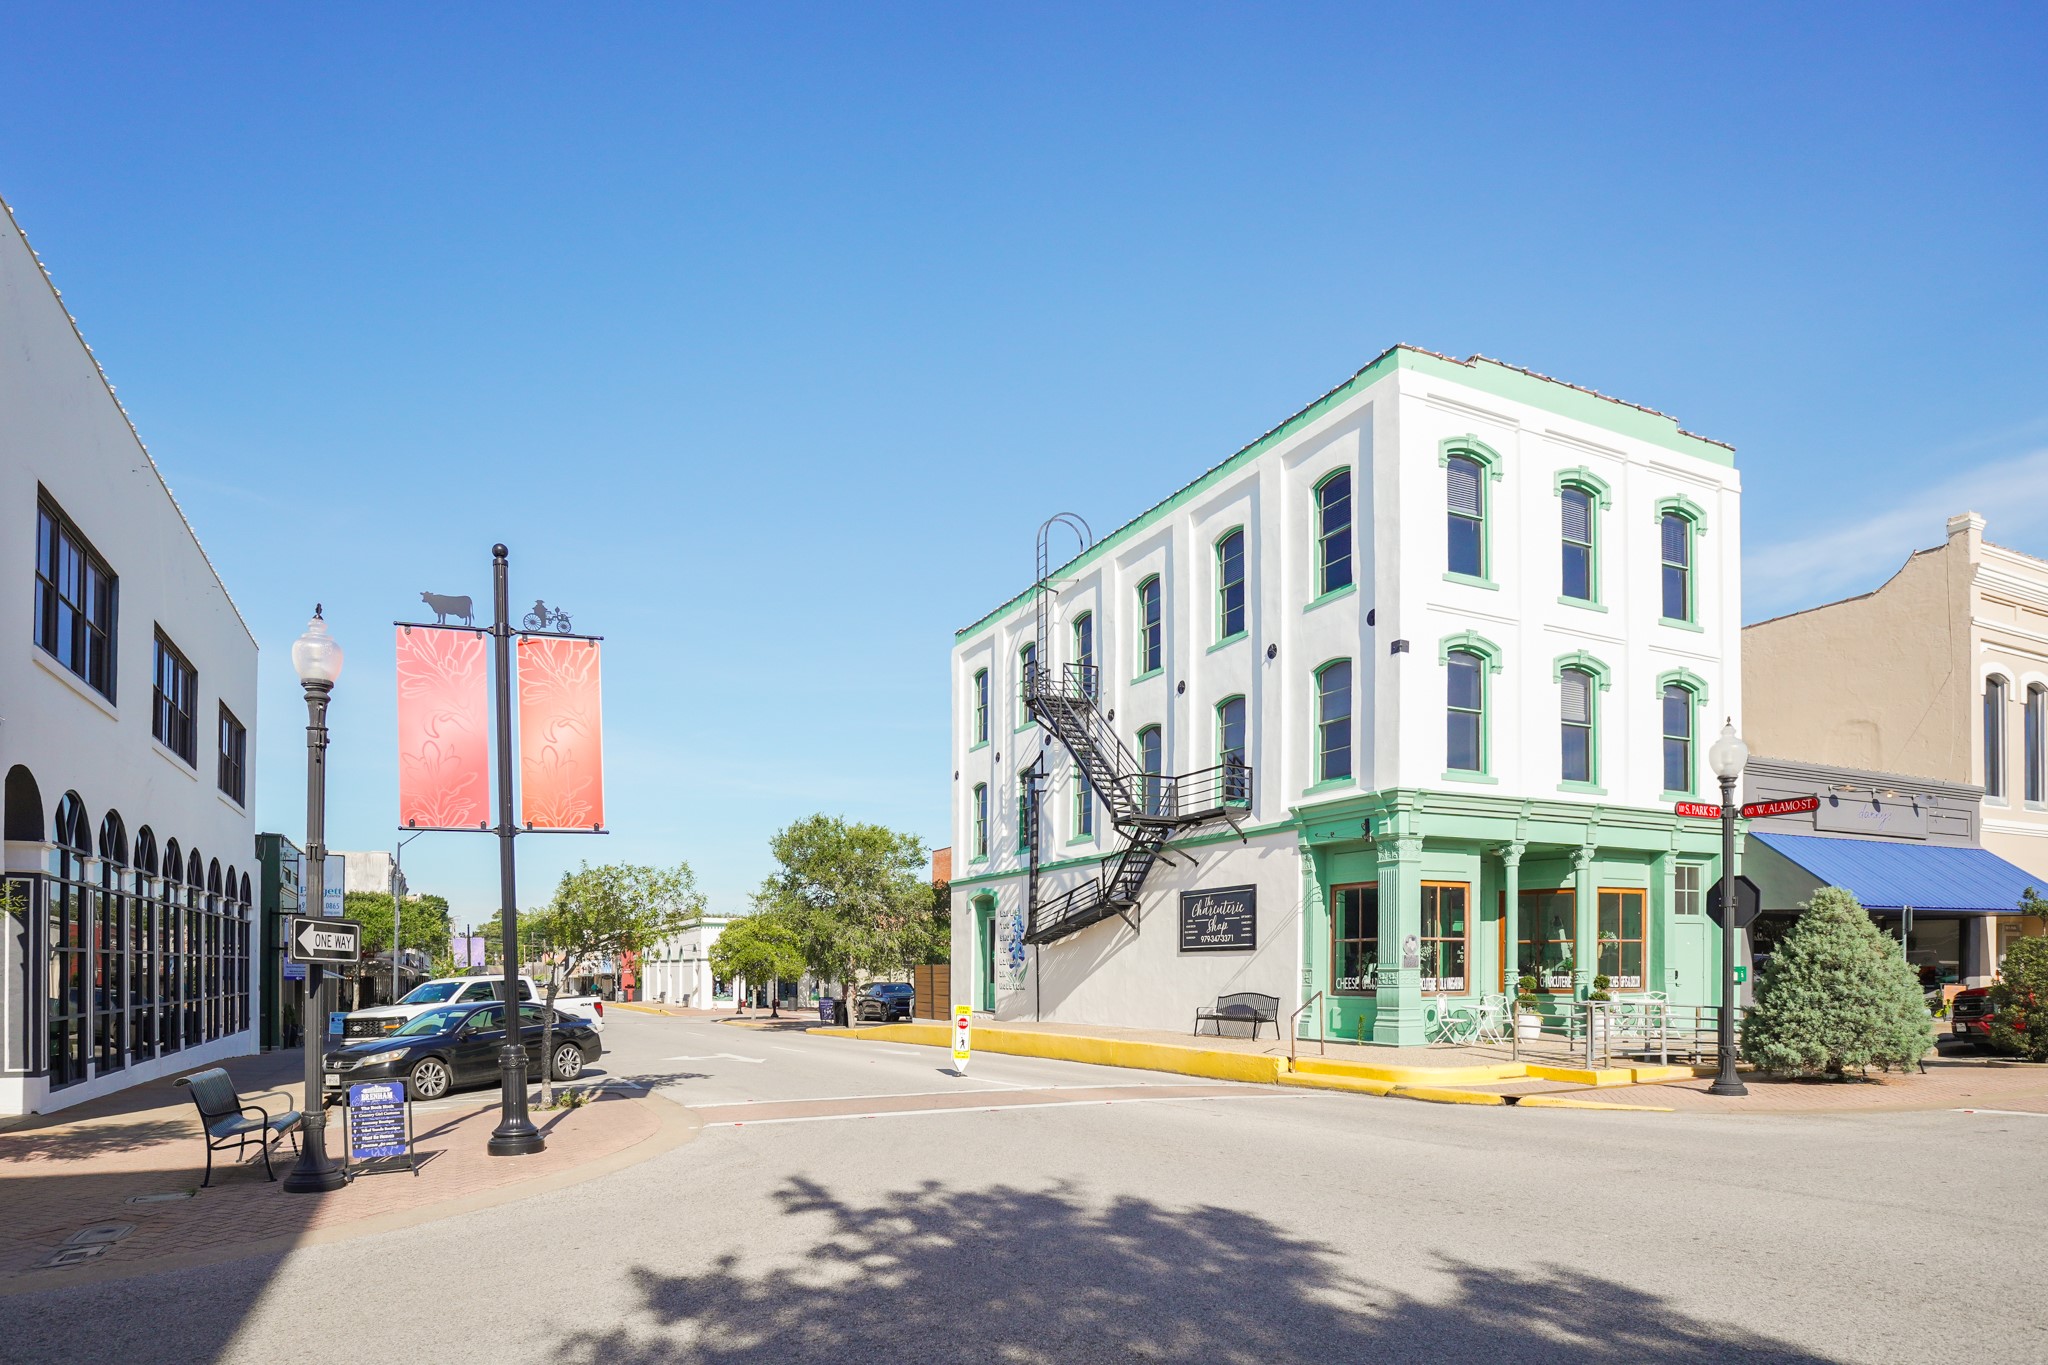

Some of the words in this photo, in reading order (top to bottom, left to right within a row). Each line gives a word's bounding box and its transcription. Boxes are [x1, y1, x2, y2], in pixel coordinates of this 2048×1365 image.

[1685, 805, 1691, 815] S.
[1692, 805, 1708, 816] PARK
[1709, 807, 1719, 817] ST.
[1744, 807, 1755, 816] 100
[1756, 804, 1767, 814] W.
[1768, 800, 1800, 814] ALAMO
[1801, 799, 1815, 810] ST.
[1191, 899, 1244, 918] Charcuterie
[1206, 915, 1228, 935] Shop
[315, 933, 332, 948] ONE
[335, 934, 352, 949] WAY
[1335, 976, 1359, 990] CHEESE
[361, 1091, 393, 1101] BRENHAM
